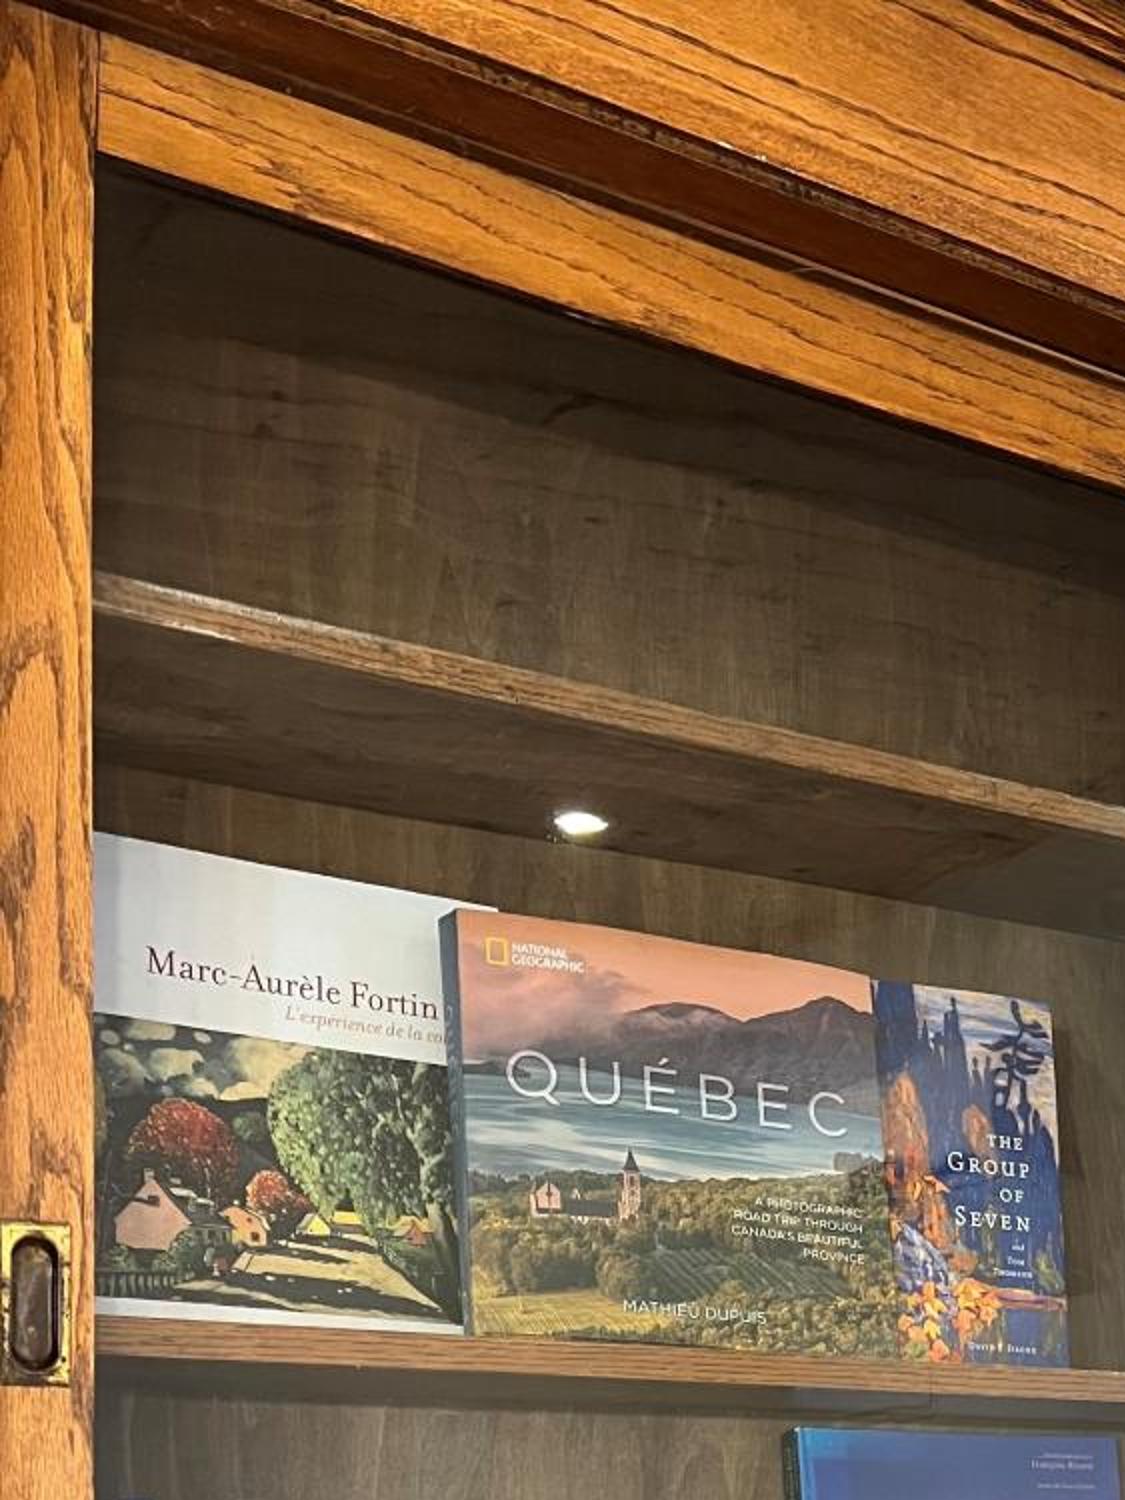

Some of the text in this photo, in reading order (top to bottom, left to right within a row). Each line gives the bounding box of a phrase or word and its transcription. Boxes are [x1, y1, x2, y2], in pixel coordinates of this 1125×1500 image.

[512, 943, 568, 959] NATIONAL
[512, 954, 585, 973] GEOGRAPHIC
[146, 945, 440, 1021] Marc-Aurèle Fortin
[385, 1022, 405, 1038] de
[506, 1050, 848, 1137] QUÉBEC
[987, 1134, 1024, 1151] THE
[947, 1151, 1030, 1179] GROUP
[1000, 1188, 1025, 1203] OF
[766, 1198, 863, 1220] PHOTOGRAPHIC
[954, 1205, 1031, 1233] SEVEN
[733, 1209, 770, 1223] ROAD
[804, 1217, 863, 1234] THROUGH
[731, 1224, 863, 1249] CANADA'S BEAUTIFUL
[803, 1247, 865, 1265] PROVINCE
[623, 1300, 768, 1326] MATHIEU DUPUIS
